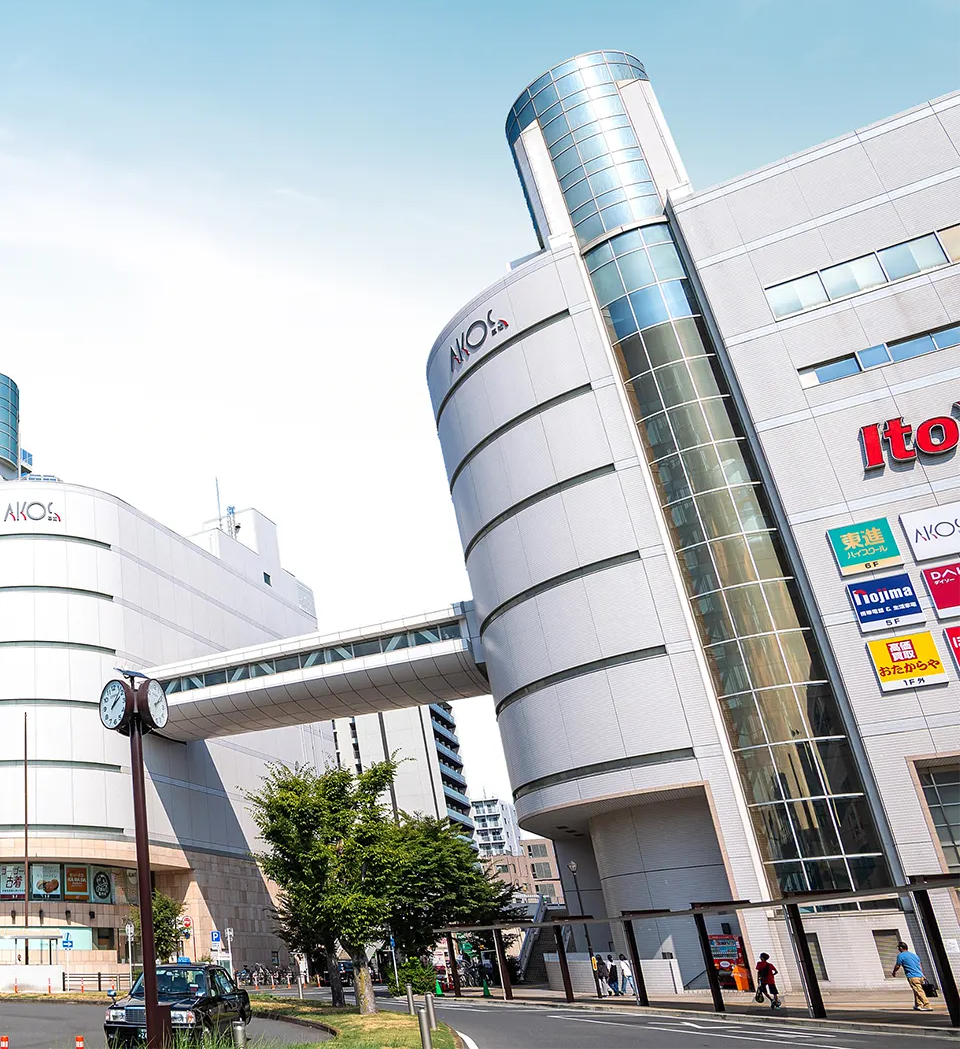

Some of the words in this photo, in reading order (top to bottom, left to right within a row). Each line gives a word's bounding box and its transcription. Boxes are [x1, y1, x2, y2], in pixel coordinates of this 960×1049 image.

[450, 308, 509, 372] AKOS
[860, 415, 959, 469] Ito
[3, 500, 61, 522] AKOS
[840, 526, 886, 551] 東進
[847, 545, 888, 560] ハイスクール
[887, 639, 913, 653] 高価
[891, 649, 916, 662] 買取
[879, 658, 940, 677] おたからや
